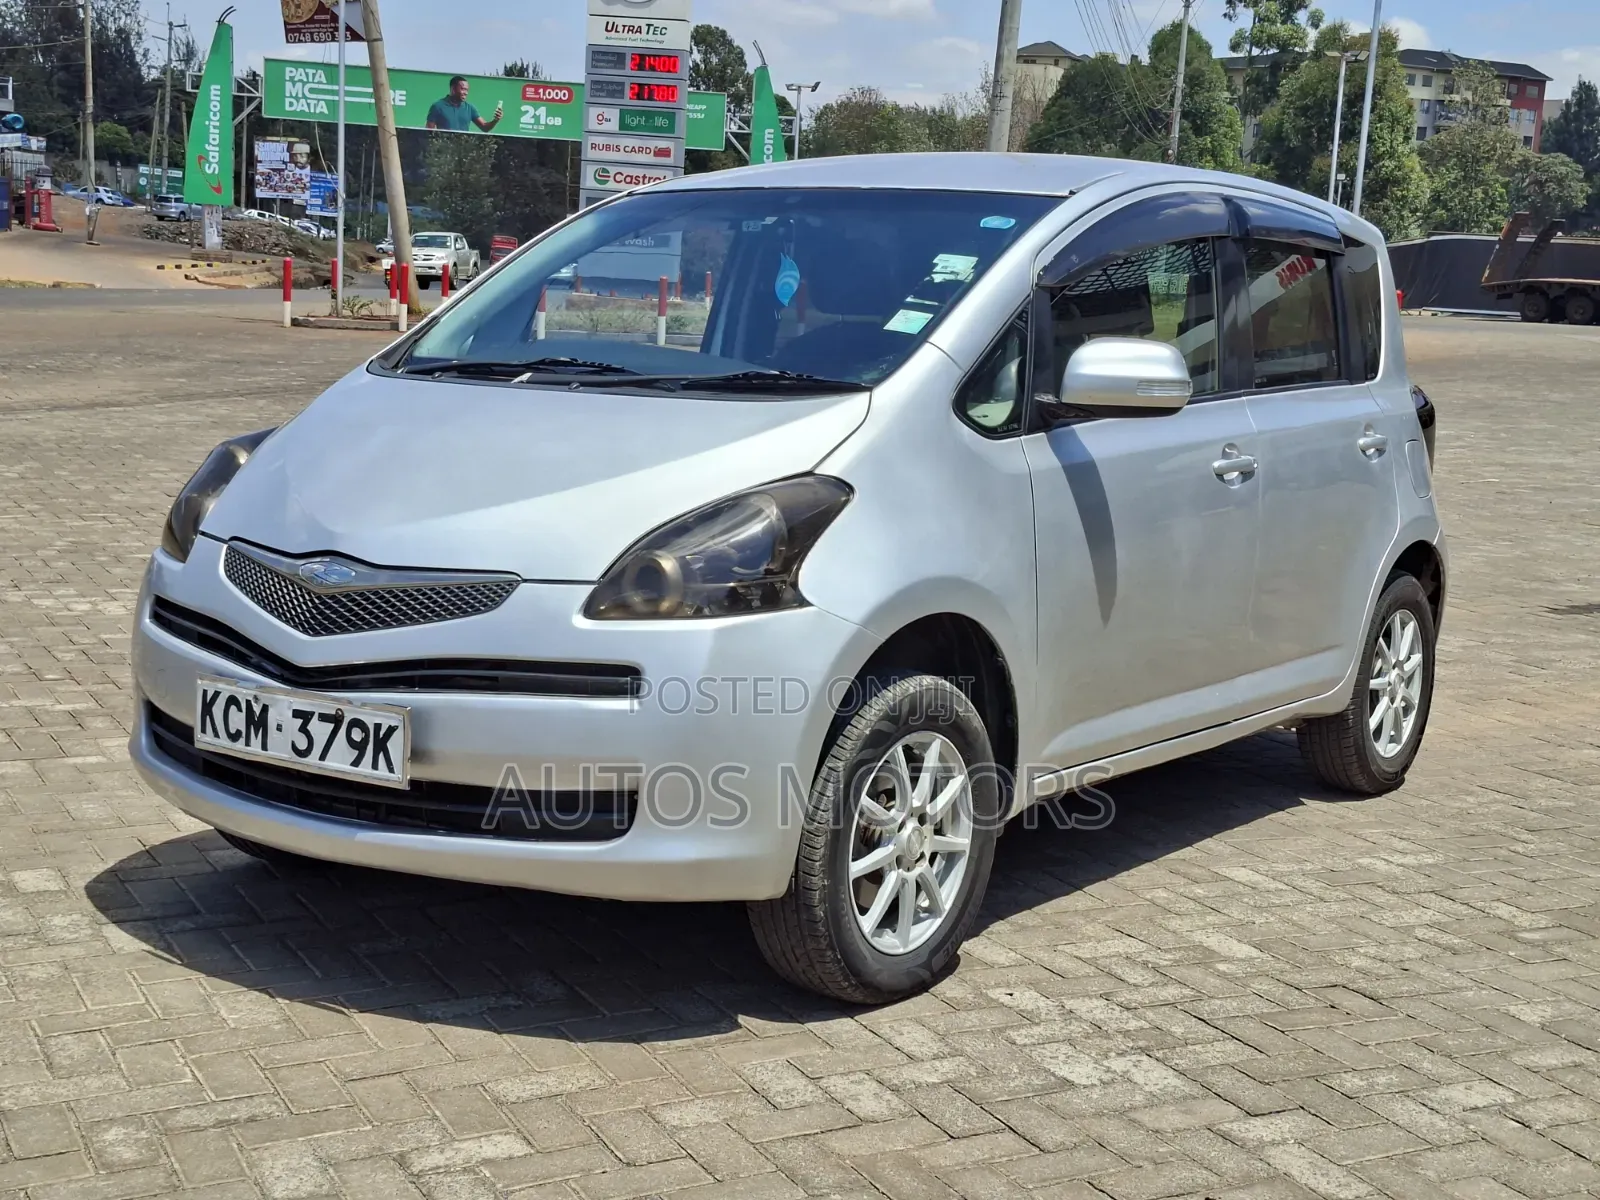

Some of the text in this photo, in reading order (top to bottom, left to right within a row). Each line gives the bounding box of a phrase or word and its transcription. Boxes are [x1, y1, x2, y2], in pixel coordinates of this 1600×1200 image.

[287, 31, 352, 42] 0748 690 33
[285, 67, 327, 83] PATA
[538, 88, 569, 100] 1,000
[285, 98, 328, 114] DATA
[625, 114, 646, 127] light
[654, 116, 669, 127] life
[205, 84, 221, 175] Safaricom
[590, 142, 652, 155] RUBIS CARD
[613, 171, 667, 186] Castr
[200, 688, 400, 775] KCM 379K
